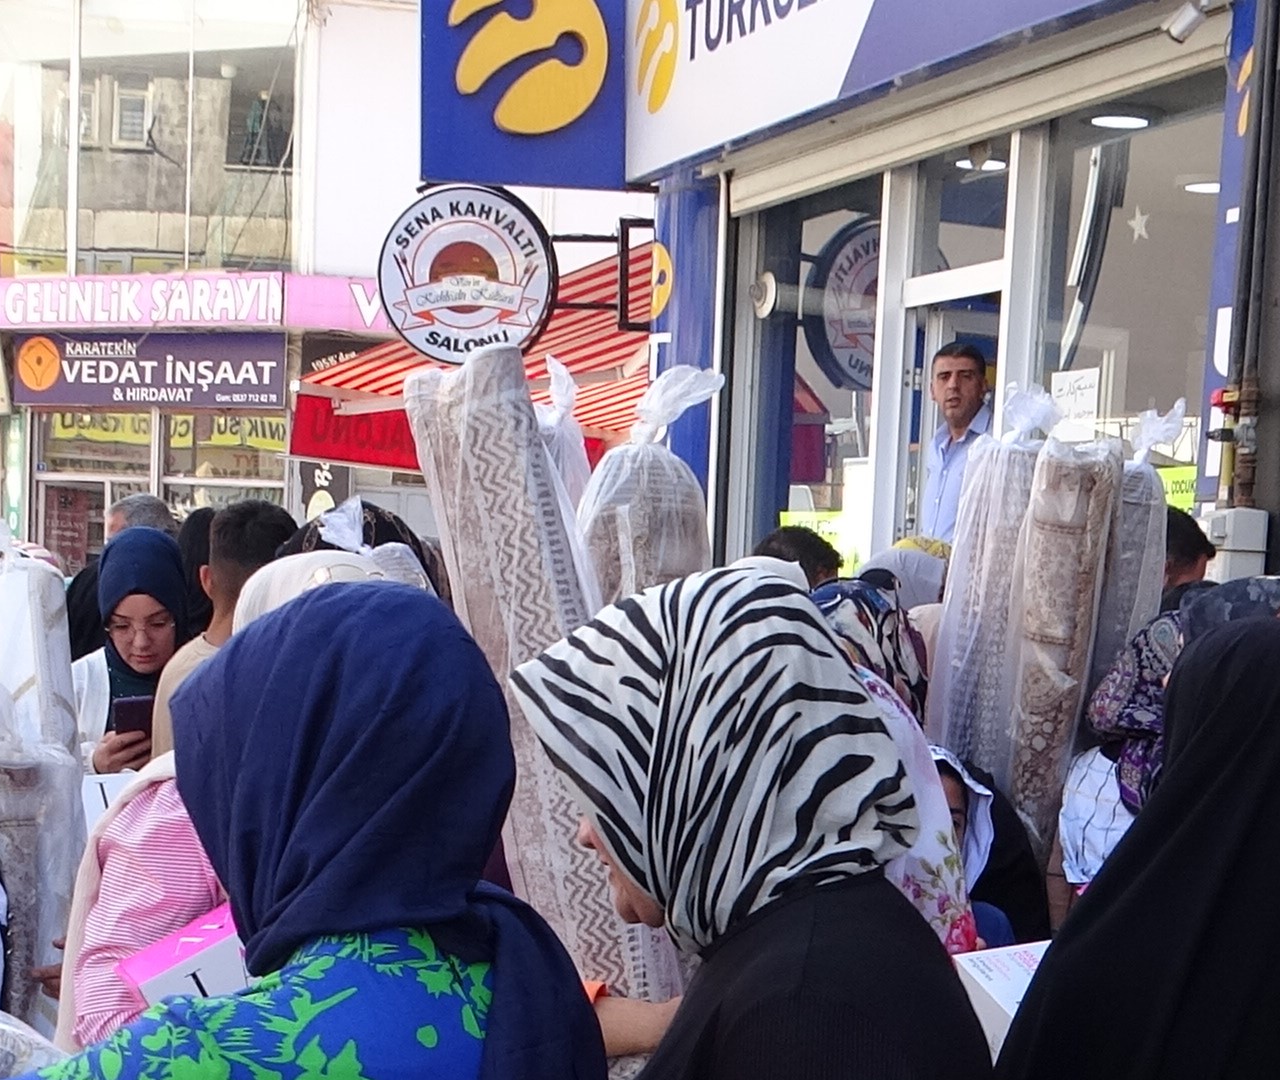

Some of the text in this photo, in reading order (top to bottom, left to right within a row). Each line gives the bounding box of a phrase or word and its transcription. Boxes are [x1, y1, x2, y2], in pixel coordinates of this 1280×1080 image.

[396, 201, 538, 258] SENA KAHVALTI
[4, 280, 144, 324] GELİNLİK
[65, 338, 136, 356] KARATEKİN
[61, 355, 276, 391] VEDAT İNŞAAT
[113, 387, 193, 402] & HIRDAVAT
